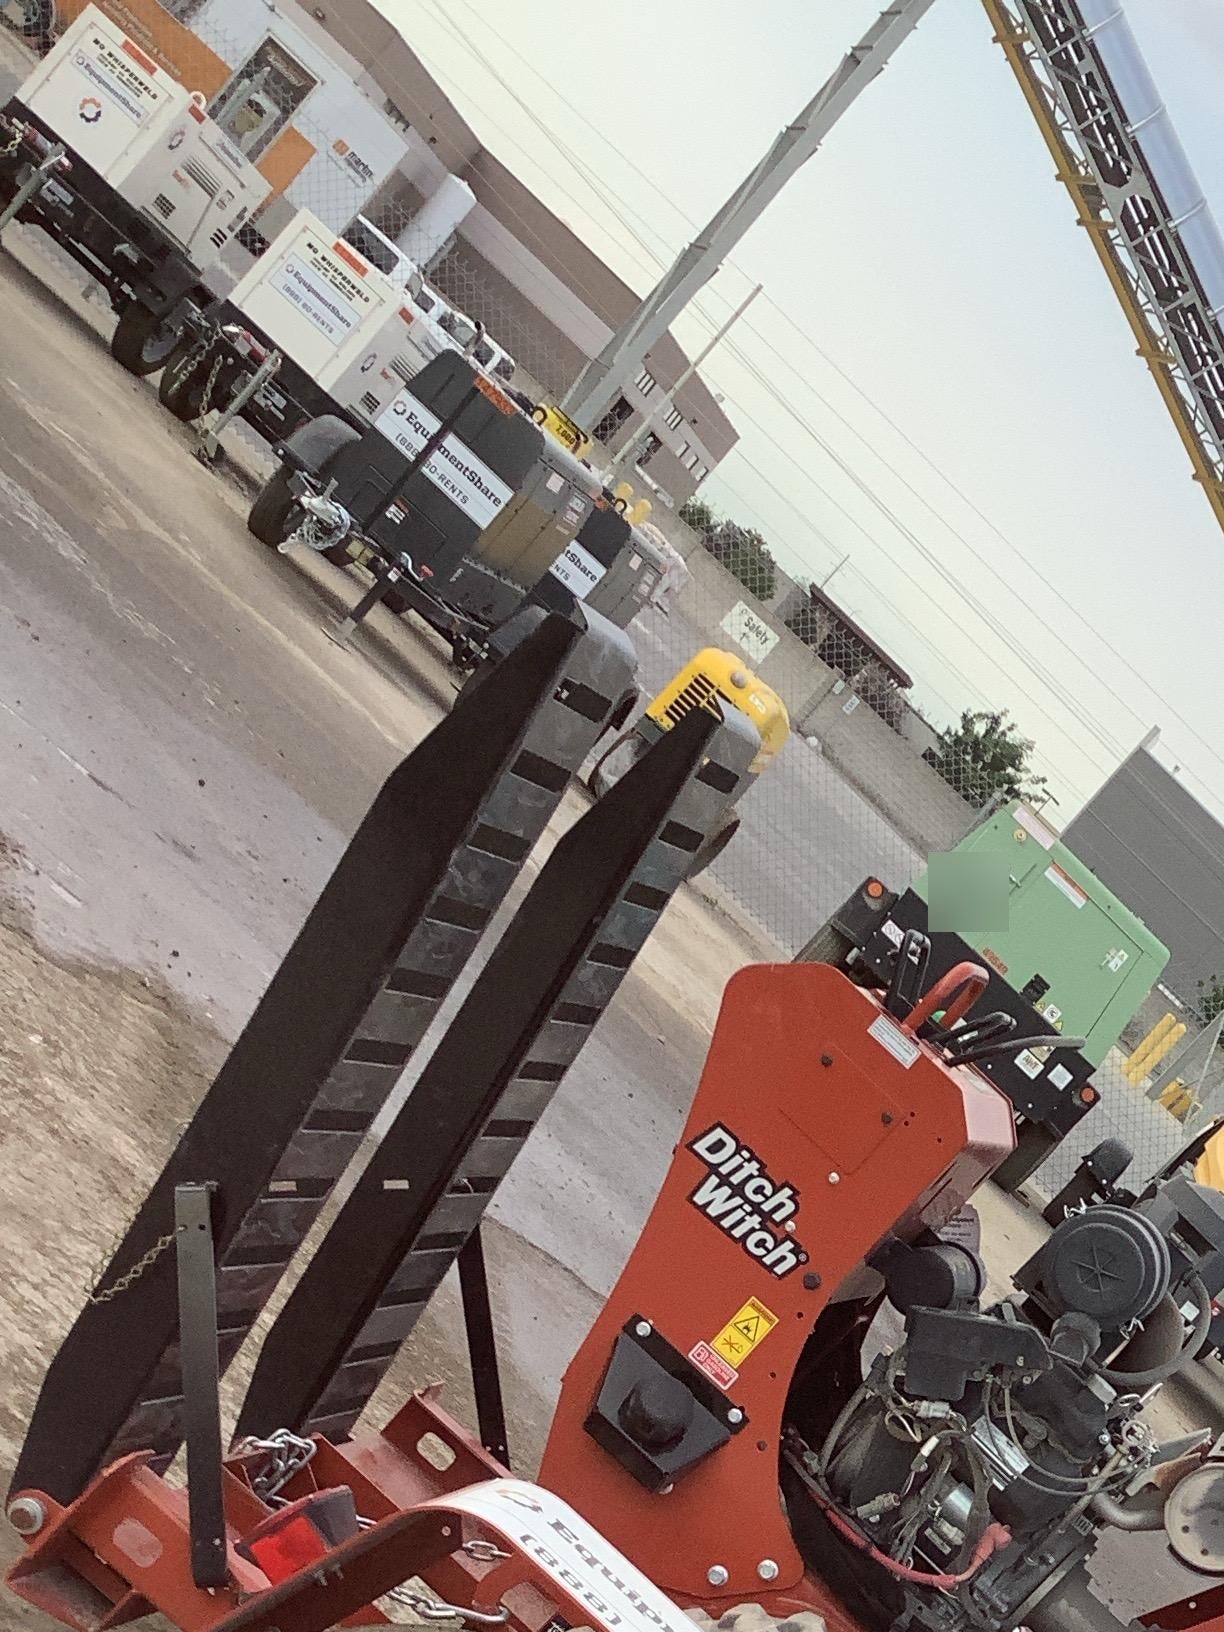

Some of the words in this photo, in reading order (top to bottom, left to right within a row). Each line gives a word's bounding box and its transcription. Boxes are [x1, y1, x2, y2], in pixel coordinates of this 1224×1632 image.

[84, 63, 141, 118] EquipmentShare
[293, 271, 351, 328] EquipmentShare
[321, 255, 370, 303] WHISPERWELD
[405, 411, 502, 508] EquimentShare
[744, 617, 770, 645] Safety
[692, 1126, 796, 1223] Ditch
[519, 1533, 623, 1626] (888)
